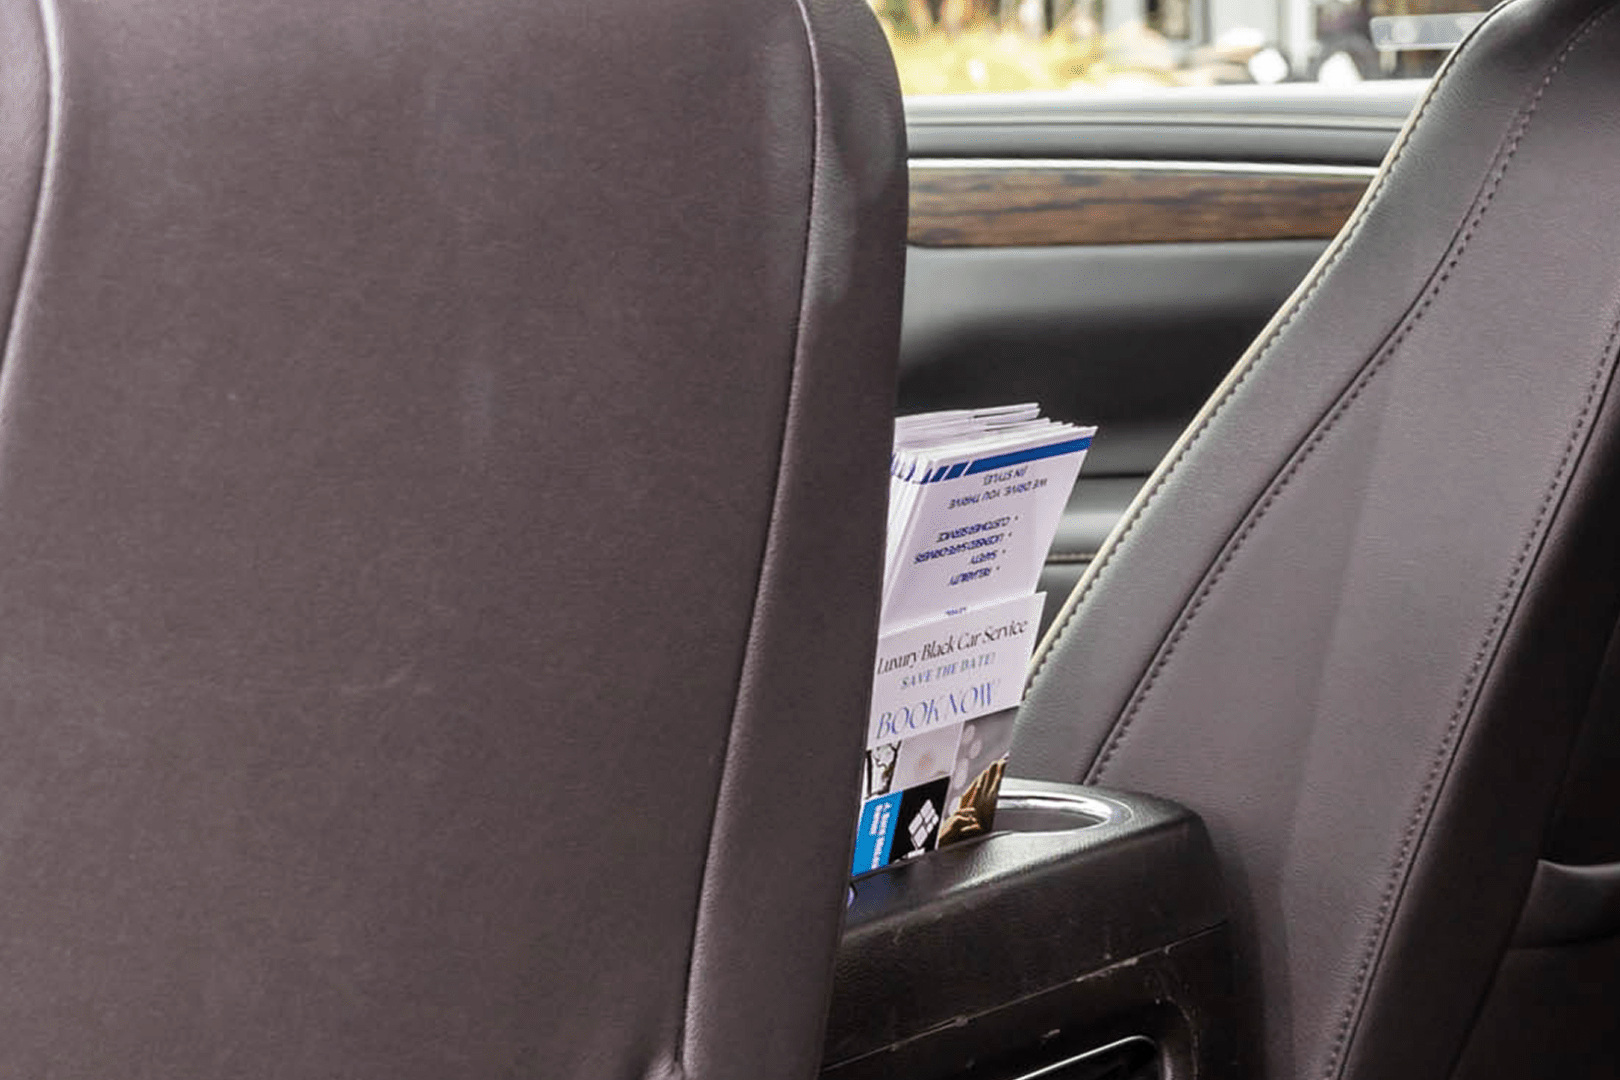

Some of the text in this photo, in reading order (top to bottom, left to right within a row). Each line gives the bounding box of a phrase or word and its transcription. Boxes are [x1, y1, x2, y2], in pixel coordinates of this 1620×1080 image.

[968, 550, 998, 565] SAFETY
[877, 620, 1028, 675] Luxury Black Car Service
[902, 670, 932, 689] SAVE
[936, 662, 958, 678] THE
[877, 681, 996, 739] BOOK NOW
